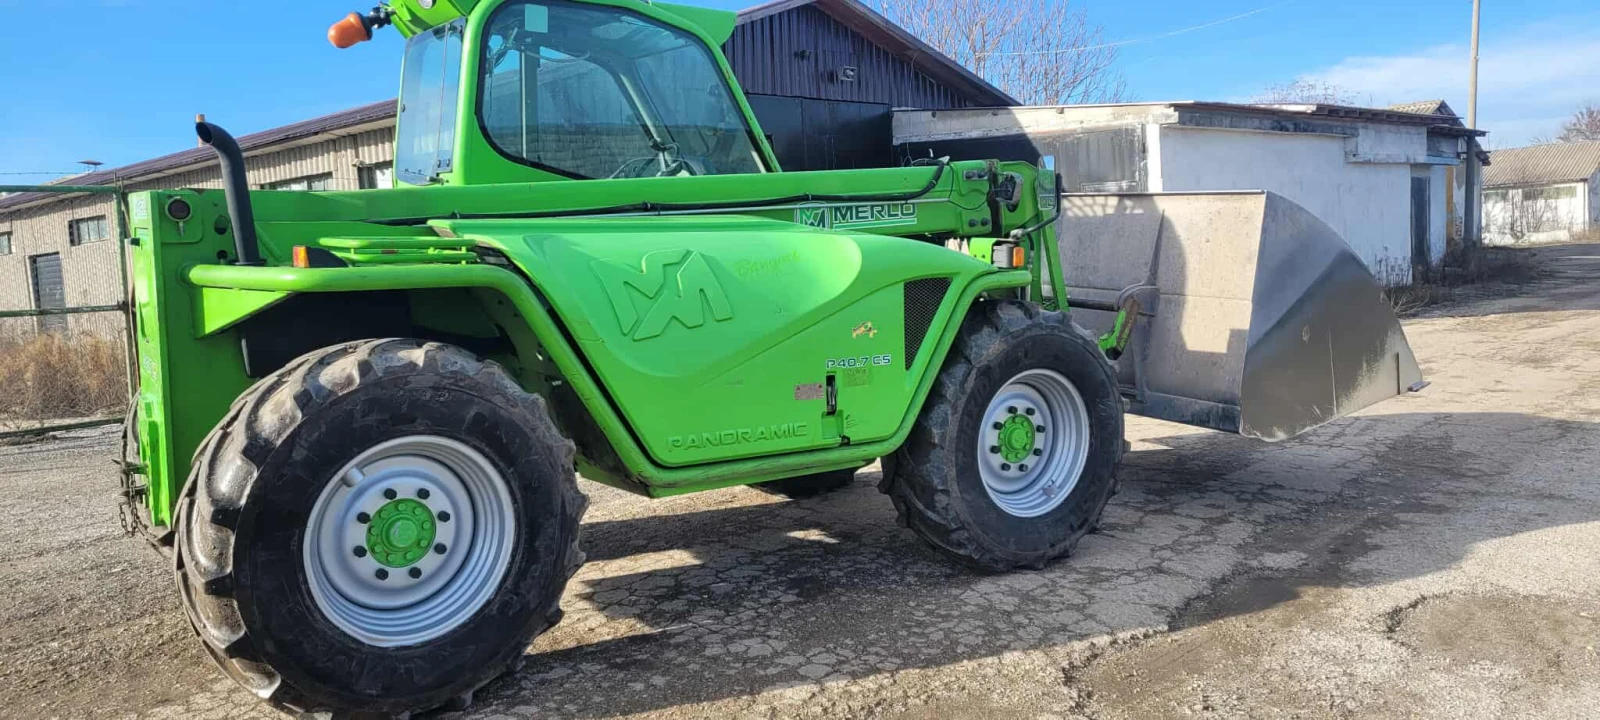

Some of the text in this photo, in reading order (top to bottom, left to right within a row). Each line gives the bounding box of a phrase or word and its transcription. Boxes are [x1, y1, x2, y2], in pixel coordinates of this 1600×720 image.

[833, 203, 917, 223] MERLO
[826, 354, 891, 369] P40.7 CS
[667, 422, 807, 452] PANORAMIC
